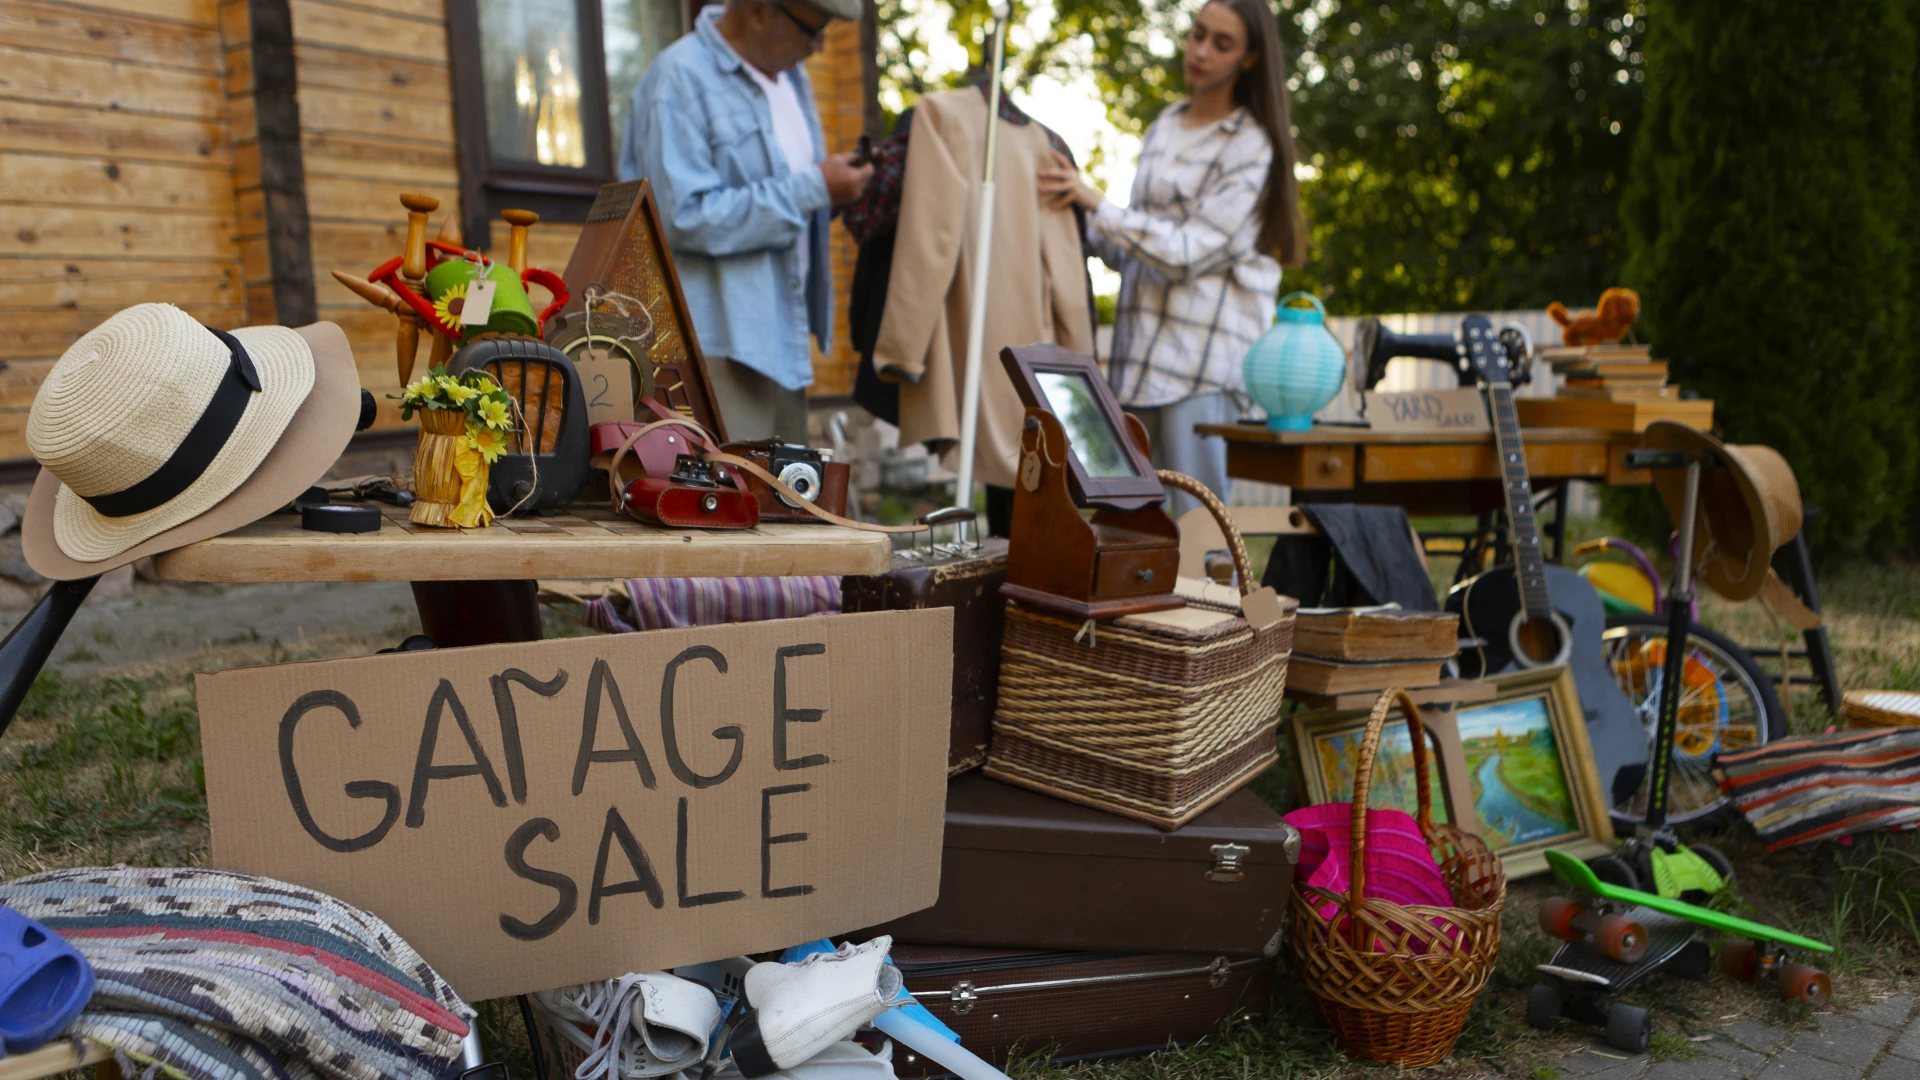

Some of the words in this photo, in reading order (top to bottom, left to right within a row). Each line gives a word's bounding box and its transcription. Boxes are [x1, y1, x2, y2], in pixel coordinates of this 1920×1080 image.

[590, 374, 614, 407] 2
[1382, 393, 1443, 423] YARD
[499, 782, 818, 941] SALE
